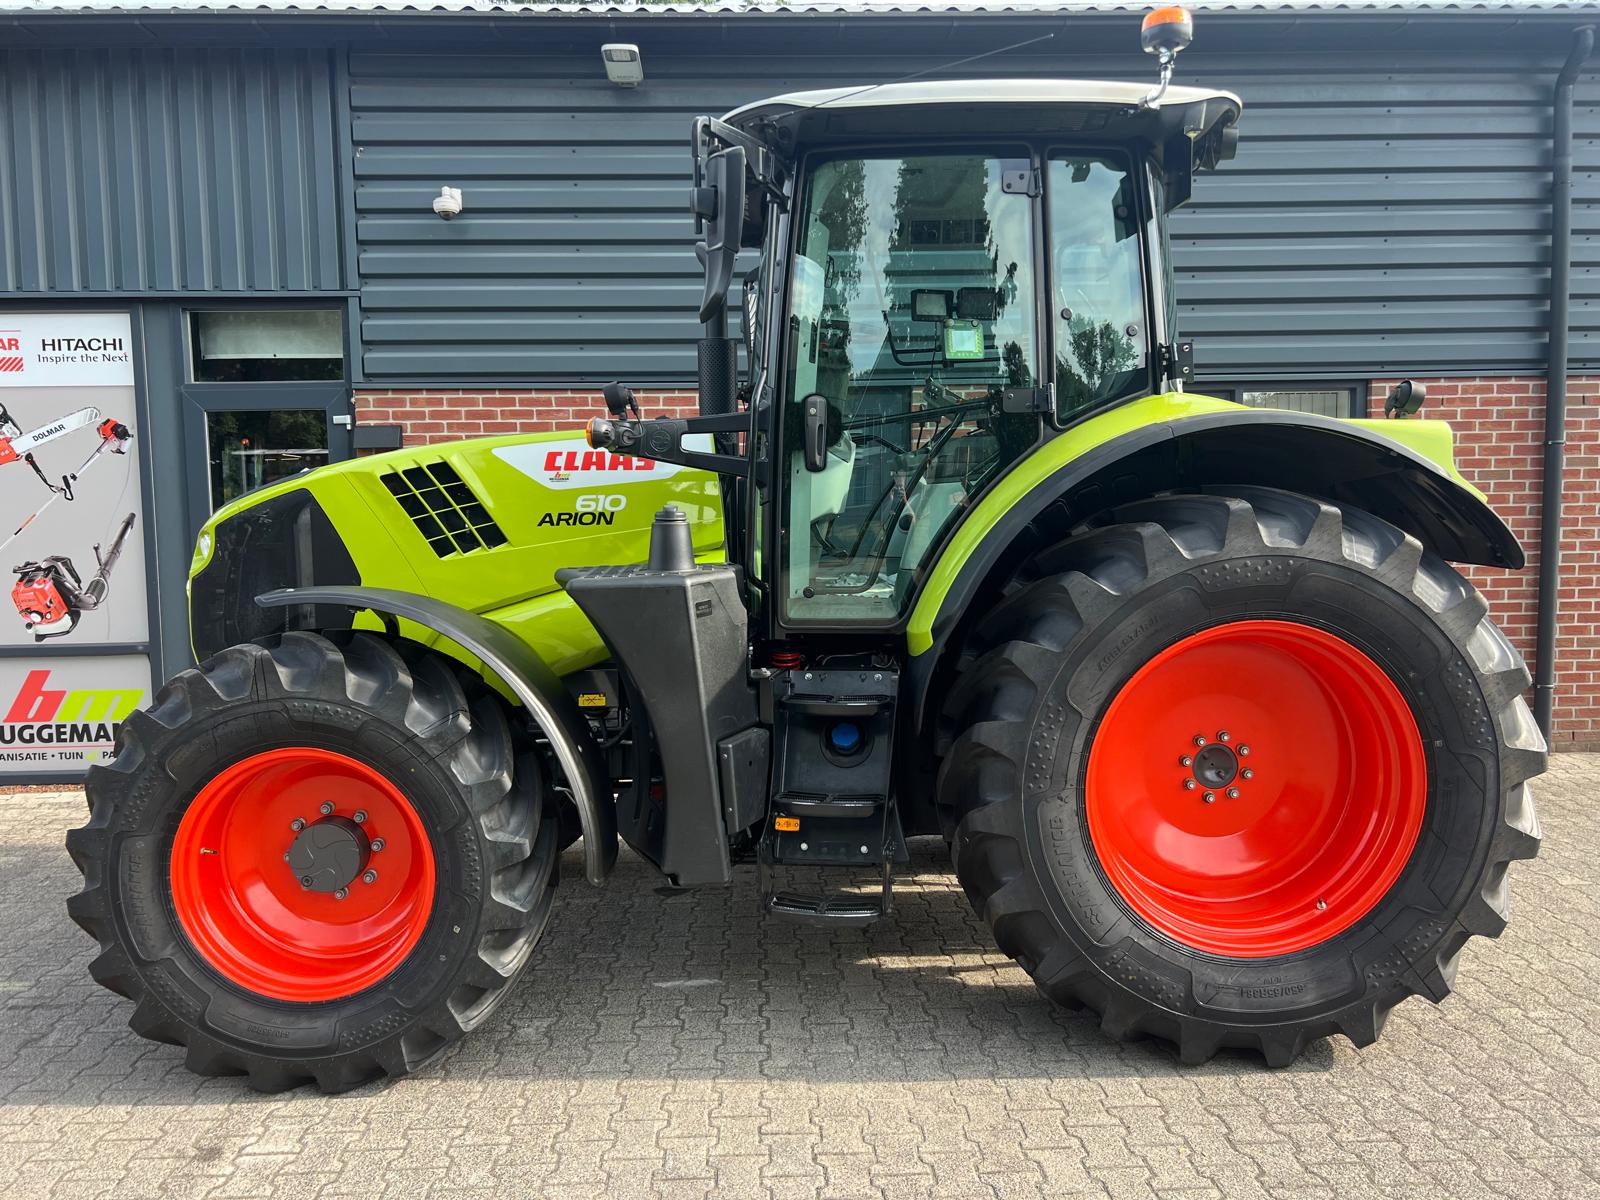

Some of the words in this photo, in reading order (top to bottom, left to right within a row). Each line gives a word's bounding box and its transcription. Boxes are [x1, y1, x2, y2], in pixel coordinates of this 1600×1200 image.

[41, 338, 123, 352] HITACHI
[37, 354, 77, 365] Inspire
[80, 354, 99, 363] the
[102, 353, 129, 363] Next
[32, 423, 66, 442] DOLMAR
[543, 451, 656, 471] CLAAS
[575, 494, 627, 512] 610
[537, 511, 615, 526] ARION
[3, 670, 145, 723] bm
[58, 751, 84, 760] TUIN
